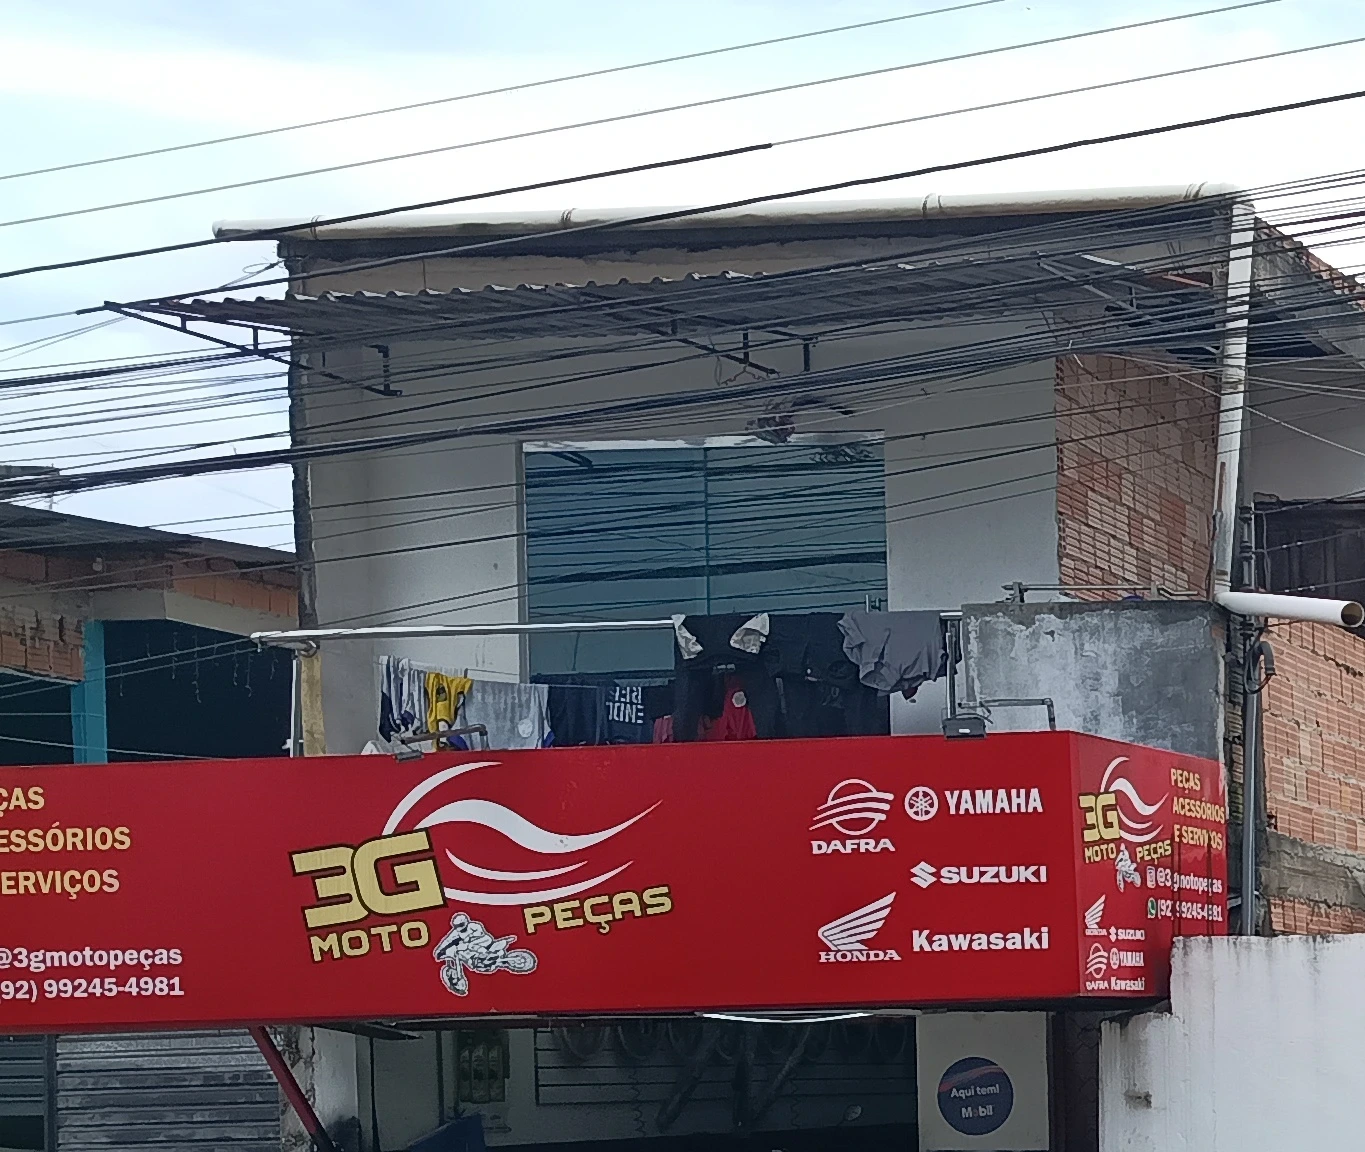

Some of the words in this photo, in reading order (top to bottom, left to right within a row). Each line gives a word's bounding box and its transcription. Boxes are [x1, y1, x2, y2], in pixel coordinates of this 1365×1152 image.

[1170, 768, 1200, 793] PEÇAS
[944, 788, 1043, 815] YAMAHA
[1173, 796, 1226, 824] ACESSÓRIOS
[1079, 793, 1120, 842] 3G
[1174, 824, 1180, 843] E
[811, 838, 896, 855] DAFRA
[1085, 843, 1117, 864] MOTO
[1136, 839, 1172, 865] PEÇAS
[290, 828, 446, 928] 3G
[940, 866, 1048, 883] SUZUKI
[309, 920, 430, 962] MOTO
[523, 885, 673, 934] PEÇAS
[912, 927, 1049, 952] Kawasaki
[818, 949, 902, 963] HONDA
[0, 979, 38, 1003] 92)
[44, 976, 185, 998] 99245-4981
[1110, 976, 1146, 991] Kawasaki
[950, 1085, 975, 1100] Aqui
[961, 1104, 994, 1119] Mobil
